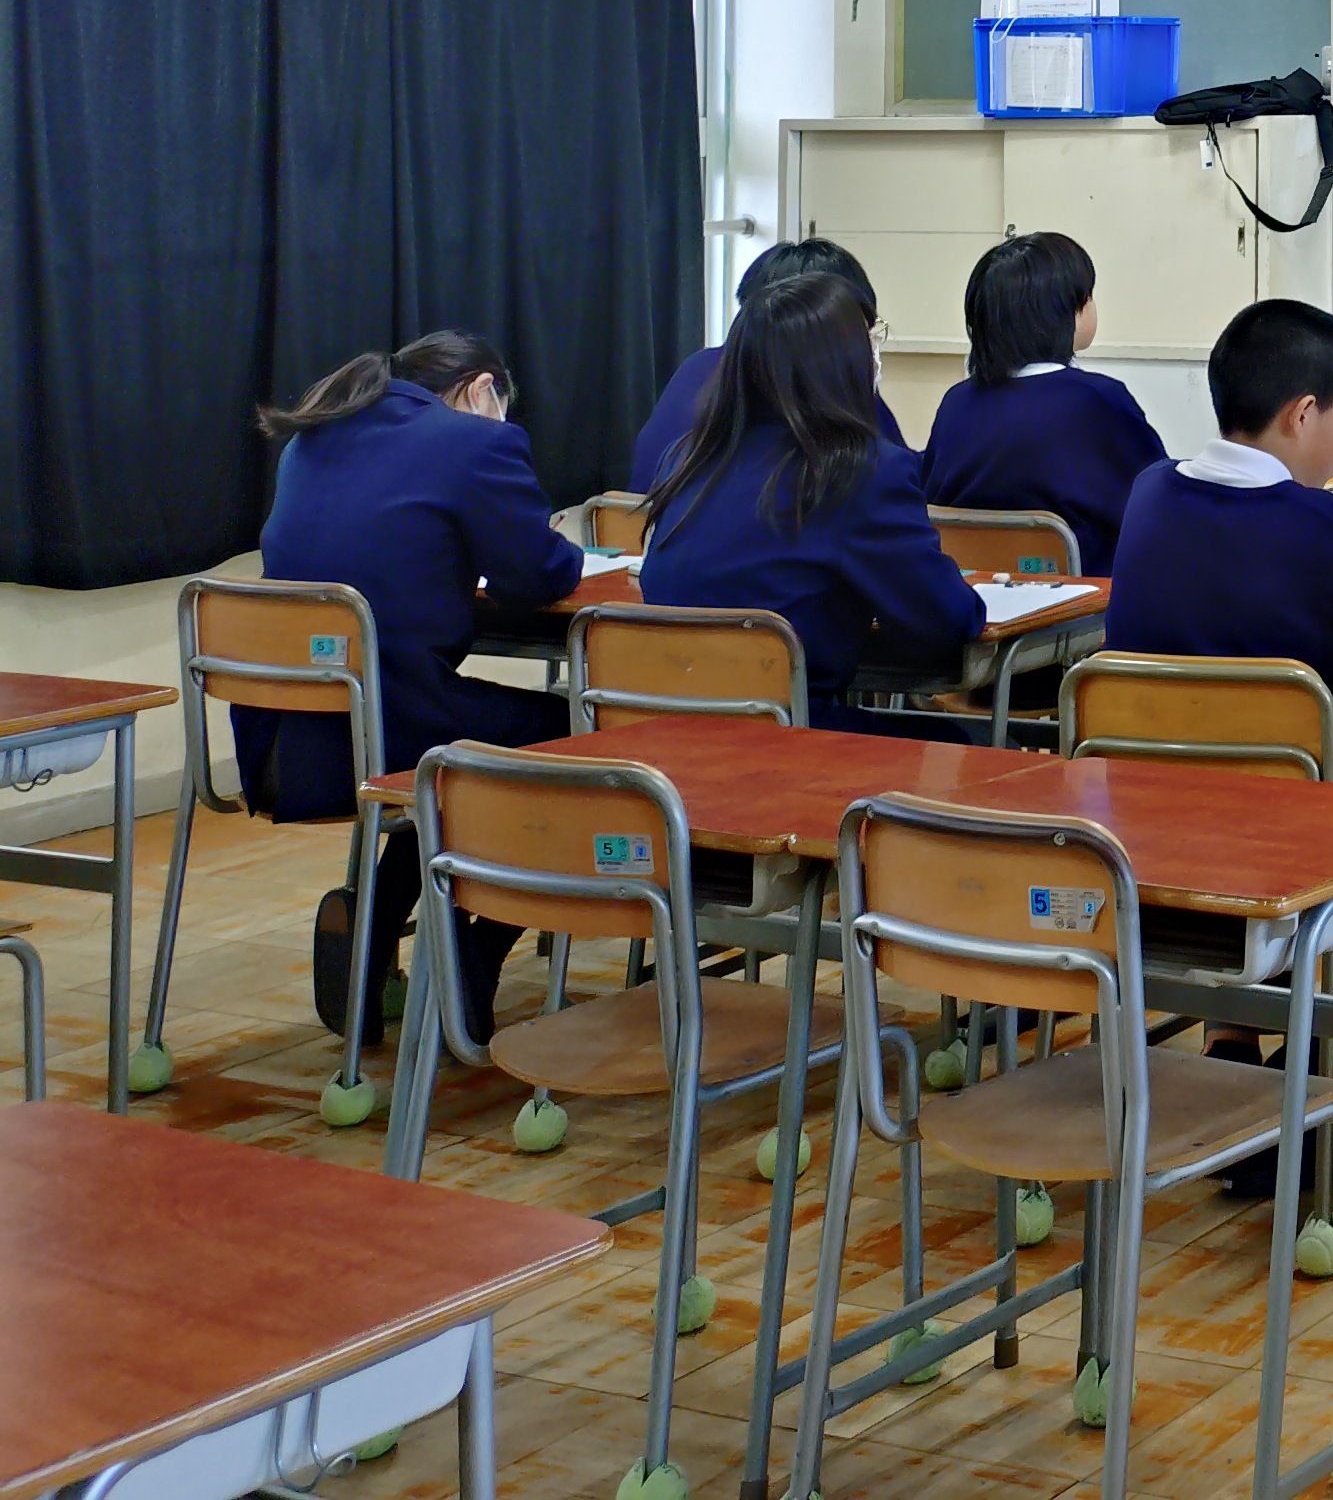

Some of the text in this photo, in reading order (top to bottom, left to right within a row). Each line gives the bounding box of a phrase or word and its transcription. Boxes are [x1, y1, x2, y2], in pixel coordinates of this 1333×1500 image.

[603, 842, 613, 856] 5
[1034, 892, 1048, 914] 5
[1087, 903, 1094, 913] 2
